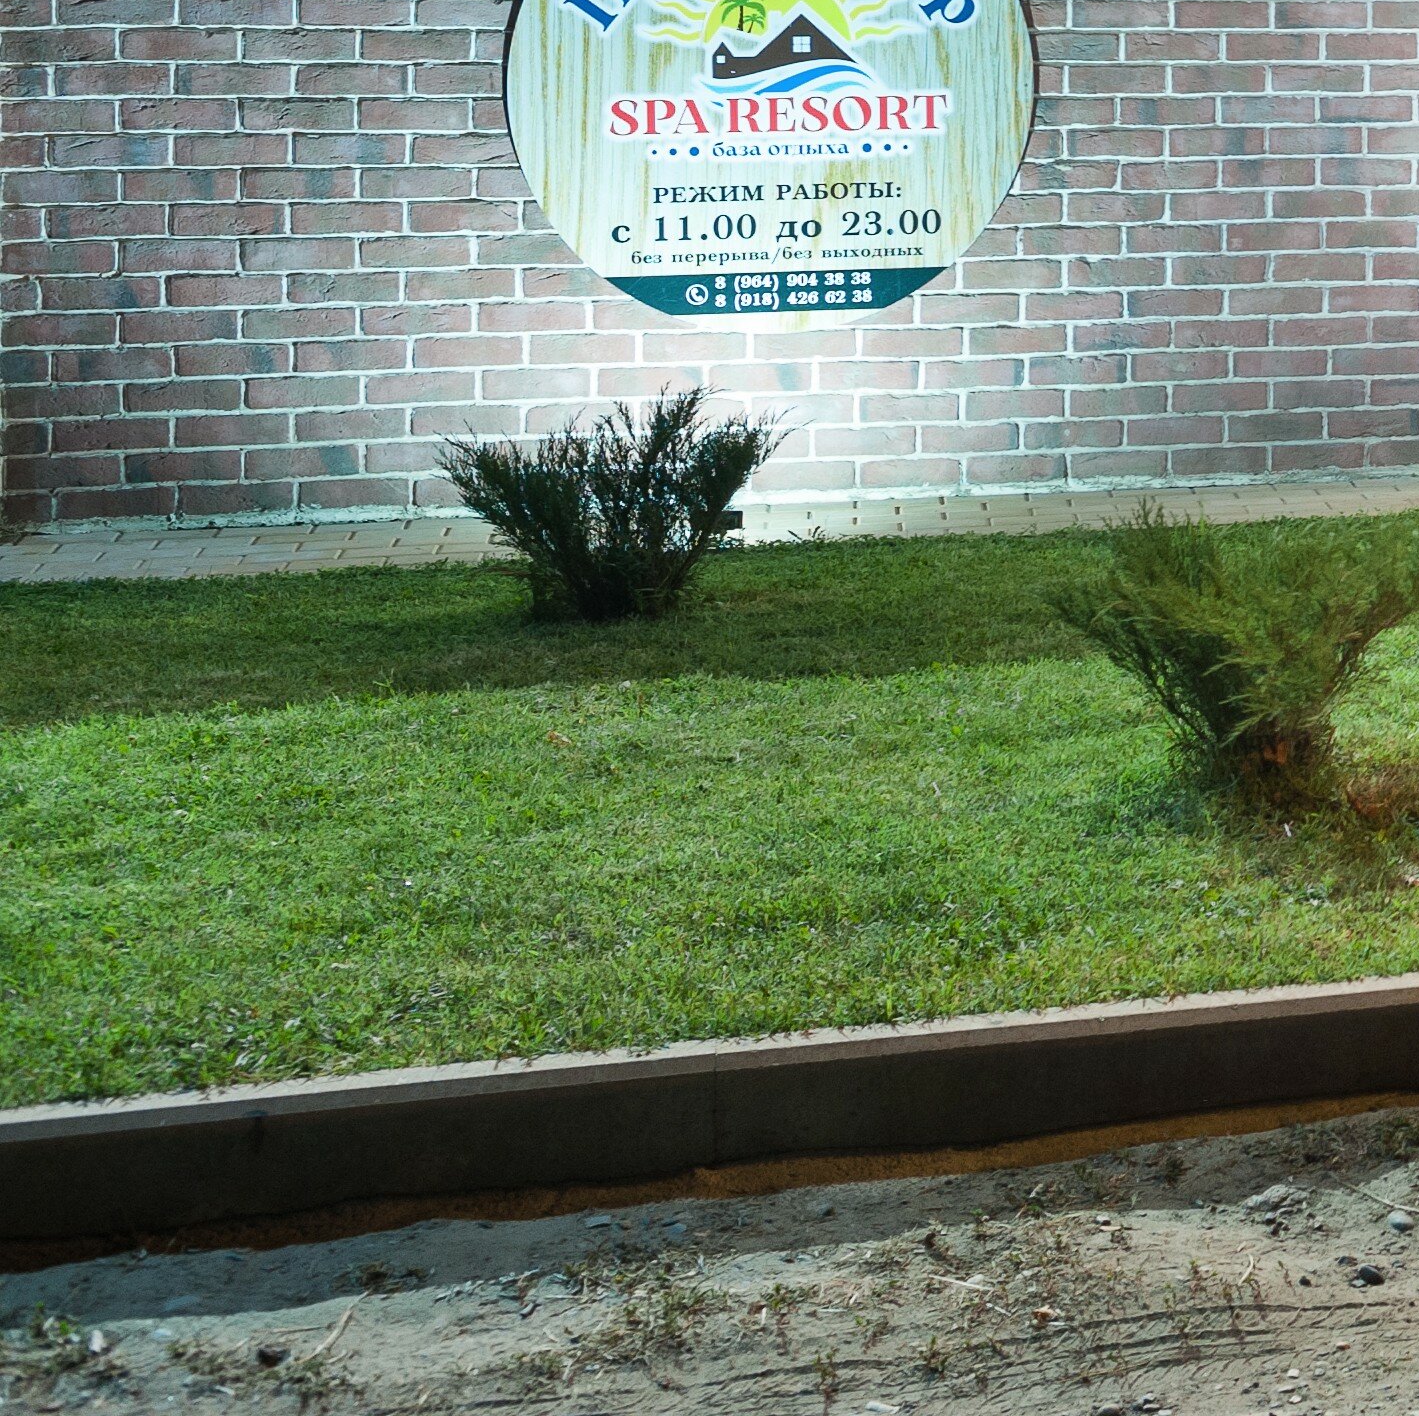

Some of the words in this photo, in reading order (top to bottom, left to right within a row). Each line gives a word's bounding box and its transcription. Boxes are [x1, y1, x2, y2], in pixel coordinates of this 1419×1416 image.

[610, 98, 709, 136] SPA
[727, 94, 947, 133] RESORT
[712, 141, 762, 158] база
[767, 142, 850, 158] отдыха
[652, 186, 763, 204] РЕЖИМ
[776, 182, 902, 200] РАБОТЫ:
[611, 224, 631, 243] с
[654, 214, 756, 242] 11.00
[775, 219, 822, 243] до
[842, 209, 941, 236] 23.00
[631, 250, 662, 265] без
[822, 246, 924, 259] выходных
[714, 275, 726, 290] 8
[733, 273, 779, 293] (964)
[787, 273, 818, 287] 904
[825, 272, 845, 286] 38
[851, 271, 872, 285] 38
[714, 294, 726, 307] 8
[733, 291, 779, 311] (918)
[787, 290, 818, 305] 426
[825, 290, 846, 304] 62
[851, 288, 872, 303] 38
